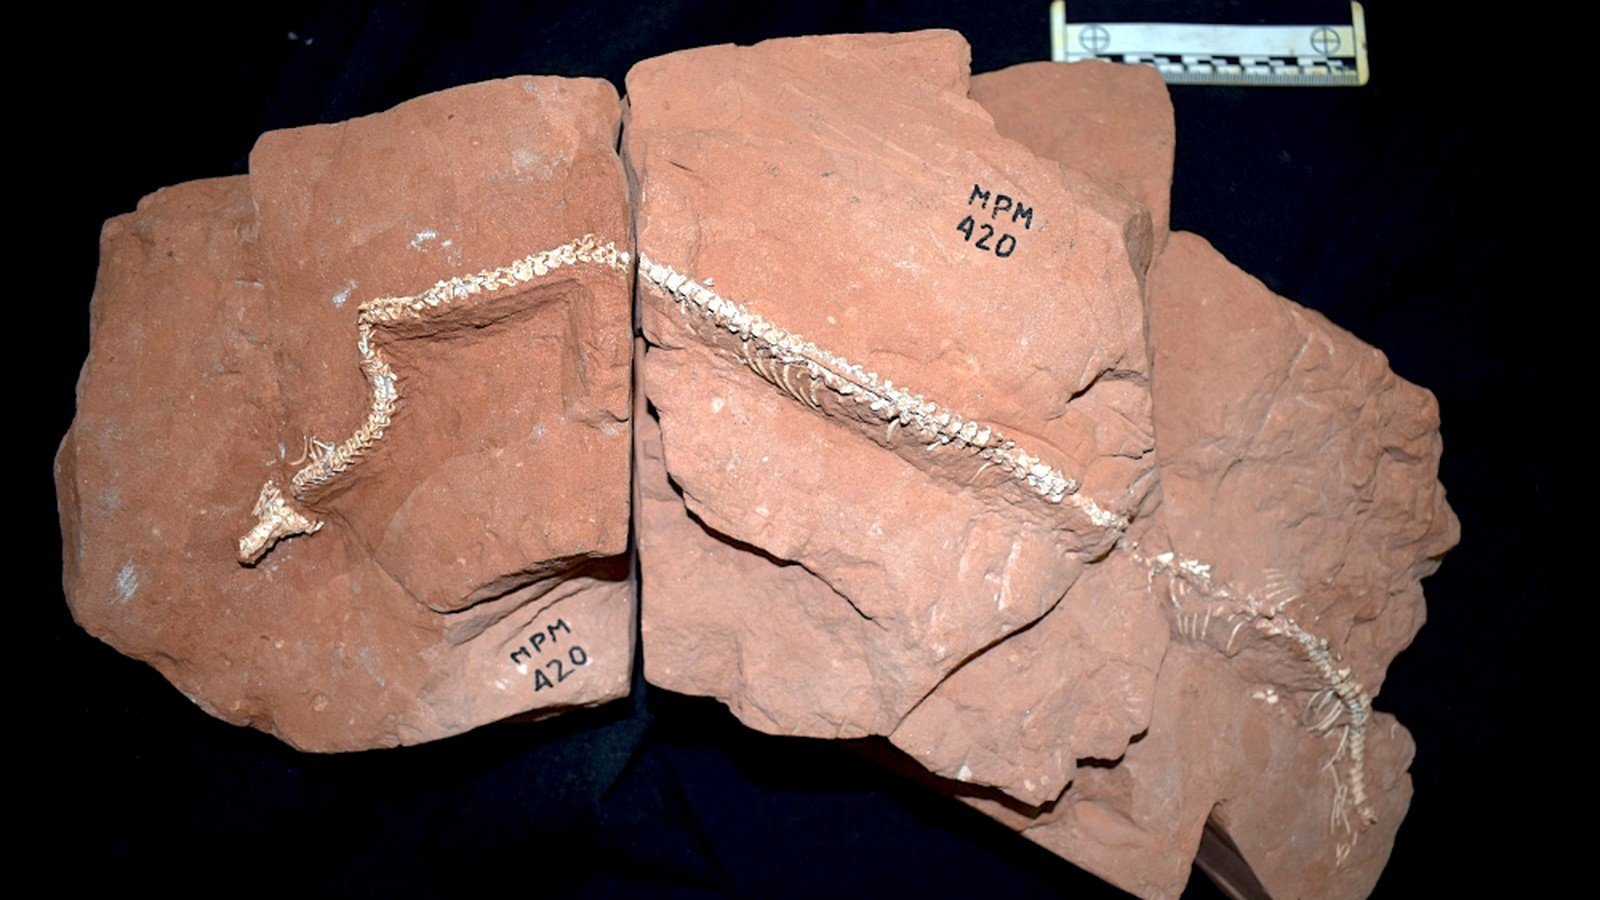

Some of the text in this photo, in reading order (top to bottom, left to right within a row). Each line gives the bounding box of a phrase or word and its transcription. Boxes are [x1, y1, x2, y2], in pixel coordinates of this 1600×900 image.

[969, 184, 1033, 229] MPM
[957, 216, 1016, 257] 420
[510, 619, 571, 664] MPM
[535, 646, 587, 691] 420
